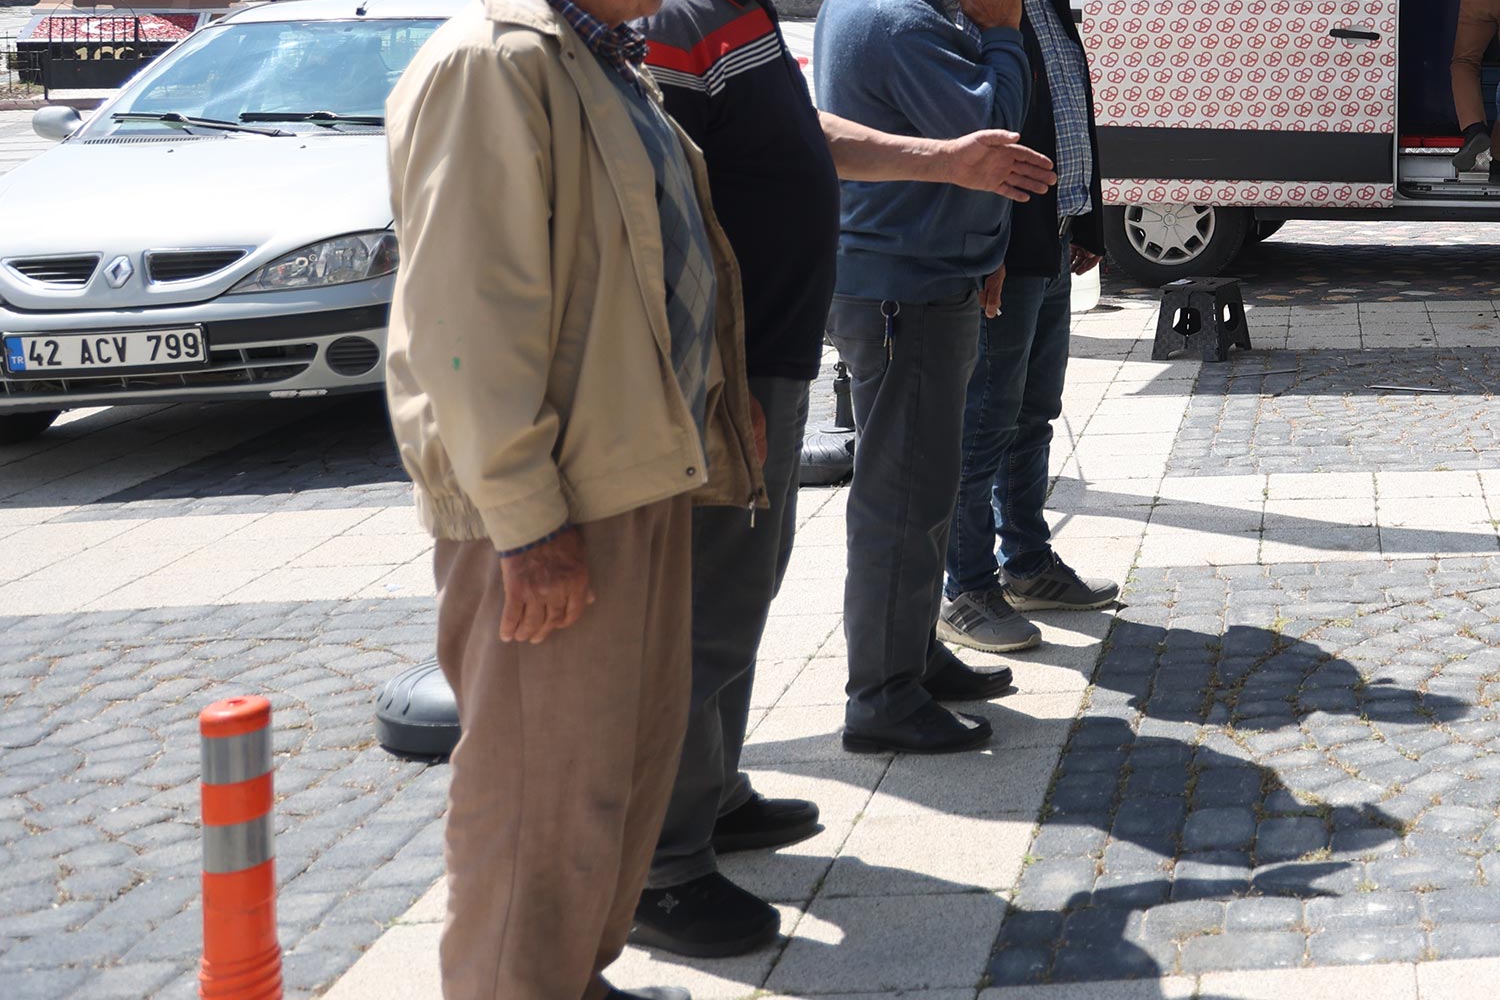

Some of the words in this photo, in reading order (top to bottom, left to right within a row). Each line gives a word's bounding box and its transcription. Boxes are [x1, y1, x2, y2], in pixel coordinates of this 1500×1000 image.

[11, 355, 25, 365] TR
[28, 340, 63, 367] 42
[80, 336, 128, 365] ACV
[146, 332, 200, 361] 799
